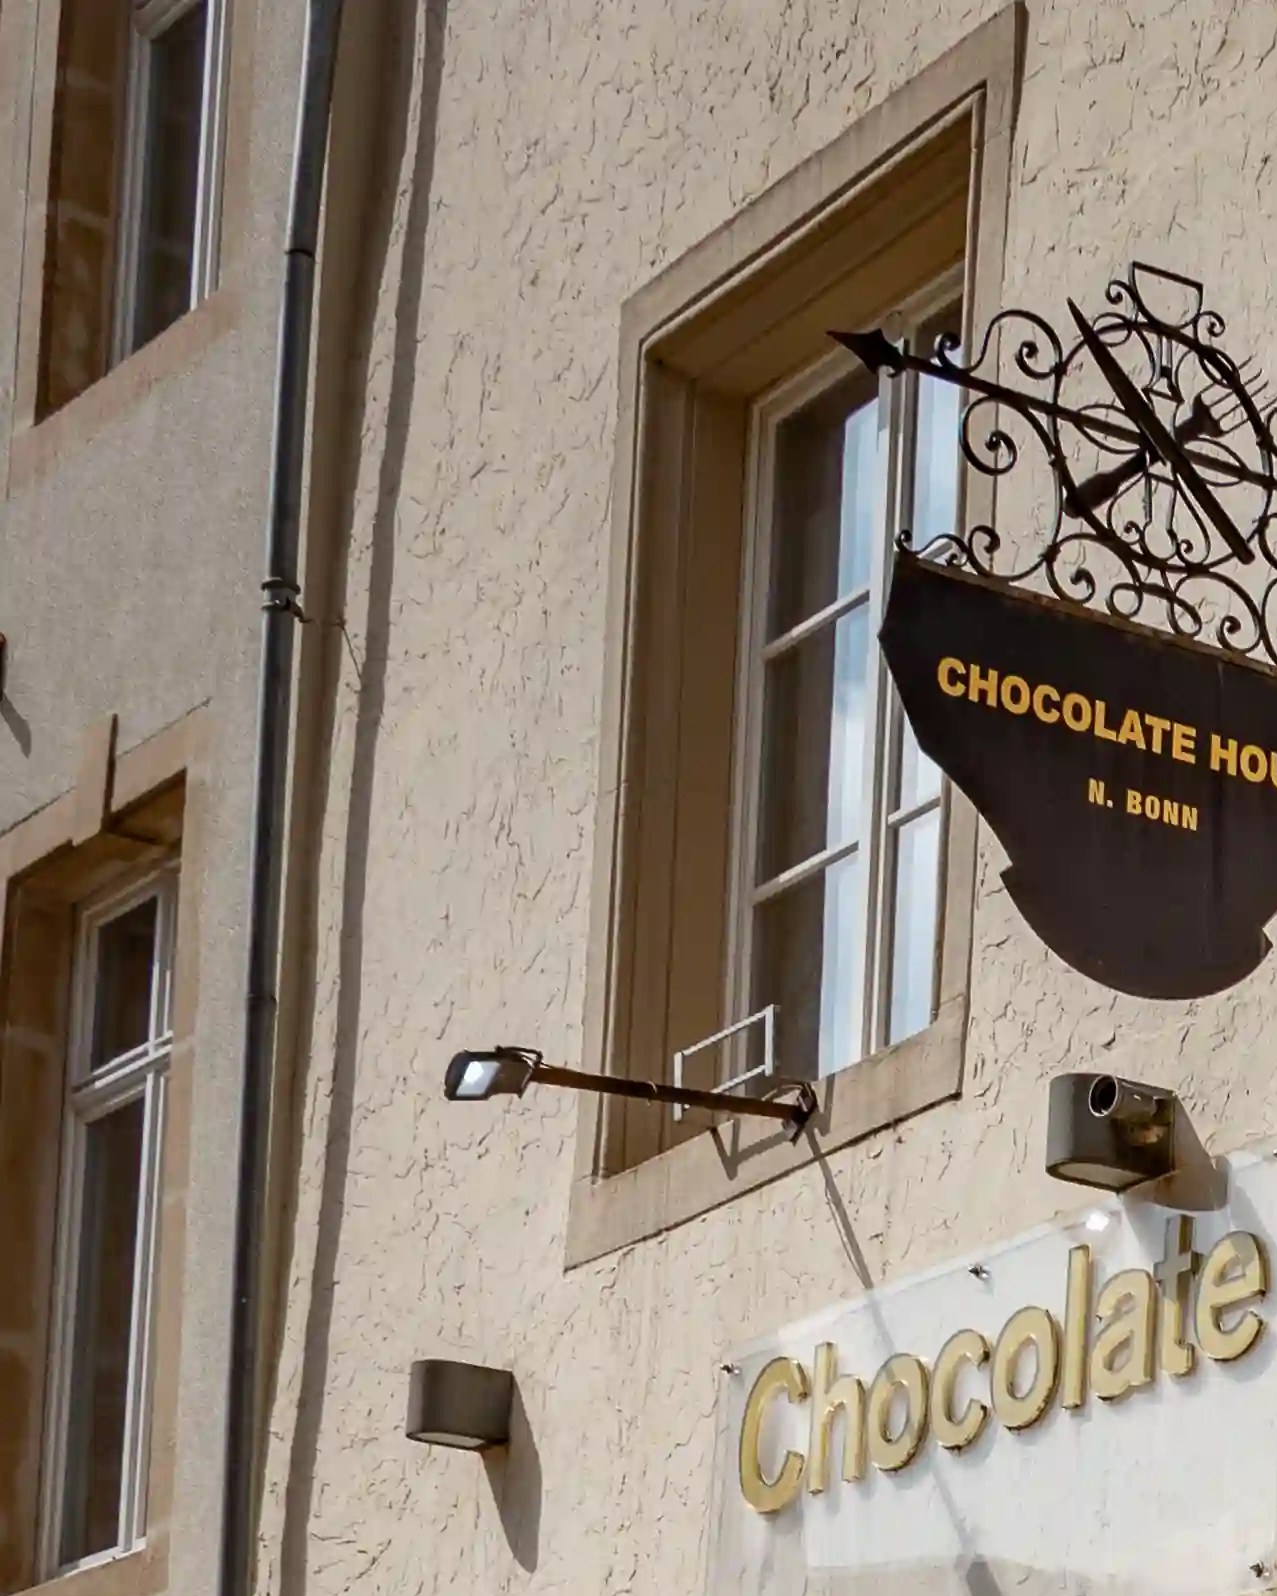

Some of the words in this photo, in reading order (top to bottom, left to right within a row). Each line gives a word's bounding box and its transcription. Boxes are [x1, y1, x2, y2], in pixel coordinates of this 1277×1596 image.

[937, 656, 1197, 764] CHOCOLATE
[1087, 778, 1114, 808] N.
[1126, 788, 1199, 832] BONN
[738, 1213, 1269, 1514] Chocolate
